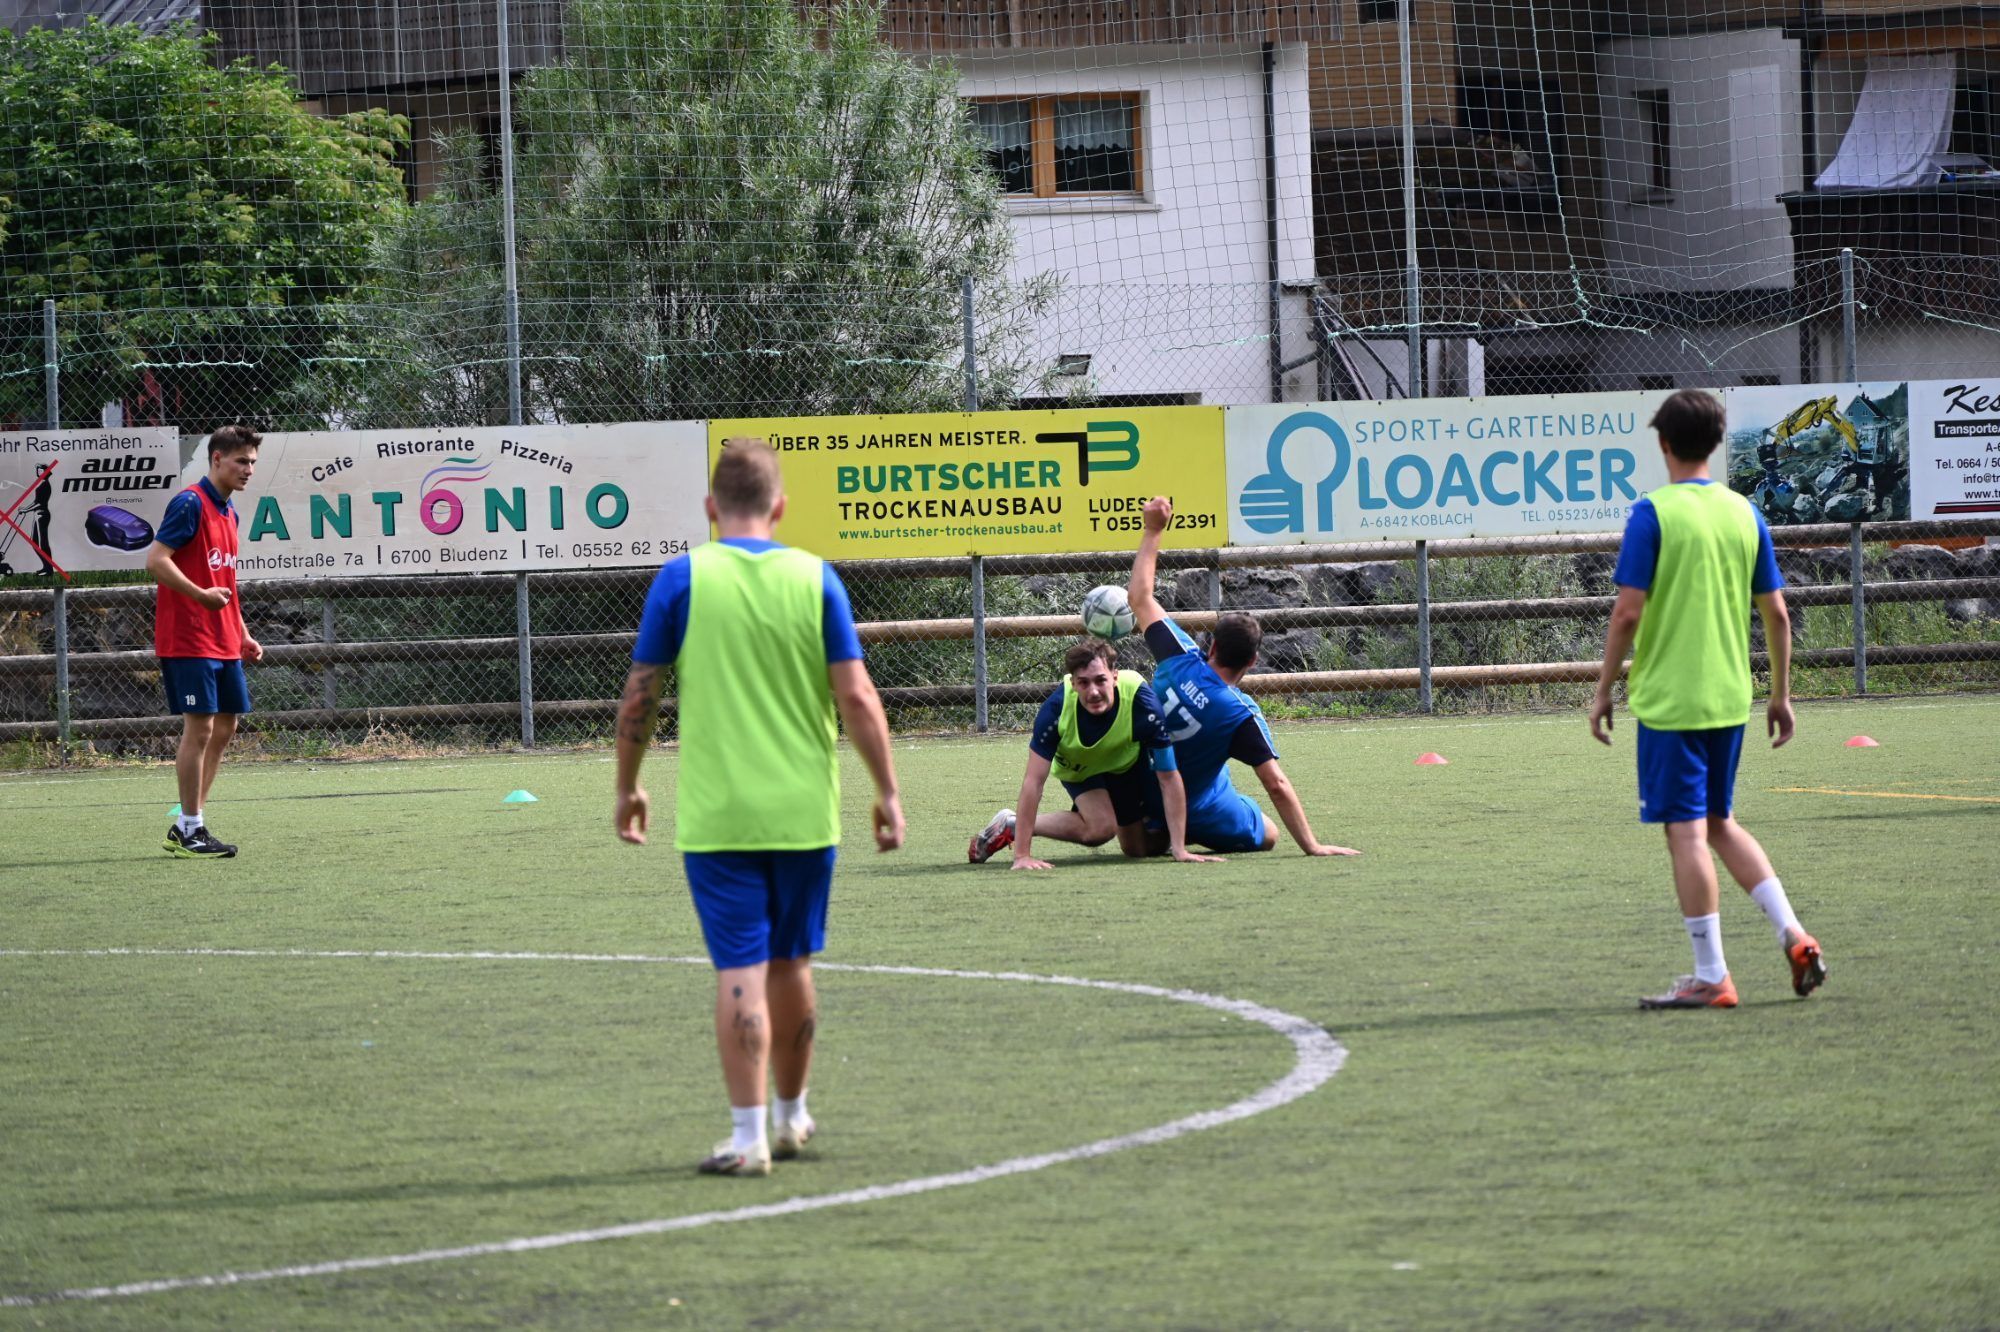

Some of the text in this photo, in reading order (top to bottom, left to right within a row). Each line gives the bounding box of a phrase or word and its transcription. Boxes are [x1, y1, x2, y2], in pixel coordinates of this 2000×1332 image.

[1356, 412, 1635, 443] SPORT+GARTENBAU
[0, 437, 20, 453] hr
[26, 435, 142, 452] Rasenmähen
[769, 433, 819, 451] ÜBER
[826, 435, 849, 449] 35
[855, 433, 932, 448] JAHREN
[939, 430, 1026, 447] MEISTER.
[81, 455, 156, 473] auto
[311, 436, 573, 482] Cafe Ristorante Pizzeria
[1935, 459, 1954, 469] Tel.
[1957, 459, 1981, 469] 0664
[62, 475, 177, 493] mower
[837, 460, 1061, 494] BURTSCHER
[1357, 448, 1637, 510] LOACKER
[248, 482, 629, 541] ANTONIO
[838, 496, 1062, 520] TROCKENAUSBAU
[1088, 497, 1173, 513] LUDES
[1521, 510, 1544, 522] TEL.
[1548, 507, 1620, 521] 05523/648
[1089, 513, 1216, 532] T 055/2391
[1360, 513, 1473, 528] A-6842 KOBLACH
[838, 522, 1063, 540] www.burtscher-trockenausbau.at
[344, 552, 364, 566] 7a
[391, 550, 431, 564] 6700
[440, 548, 508, 563] Bludenz
[536, 544, 564, 558] Tel.
[573, 542, 623, 557] 05552
[632, 541, 651, 555] 62
[659, 540, 689, 554] 354
[184, 695, 196, 706] 19
[1180, 680, 1209, 709] JULES
